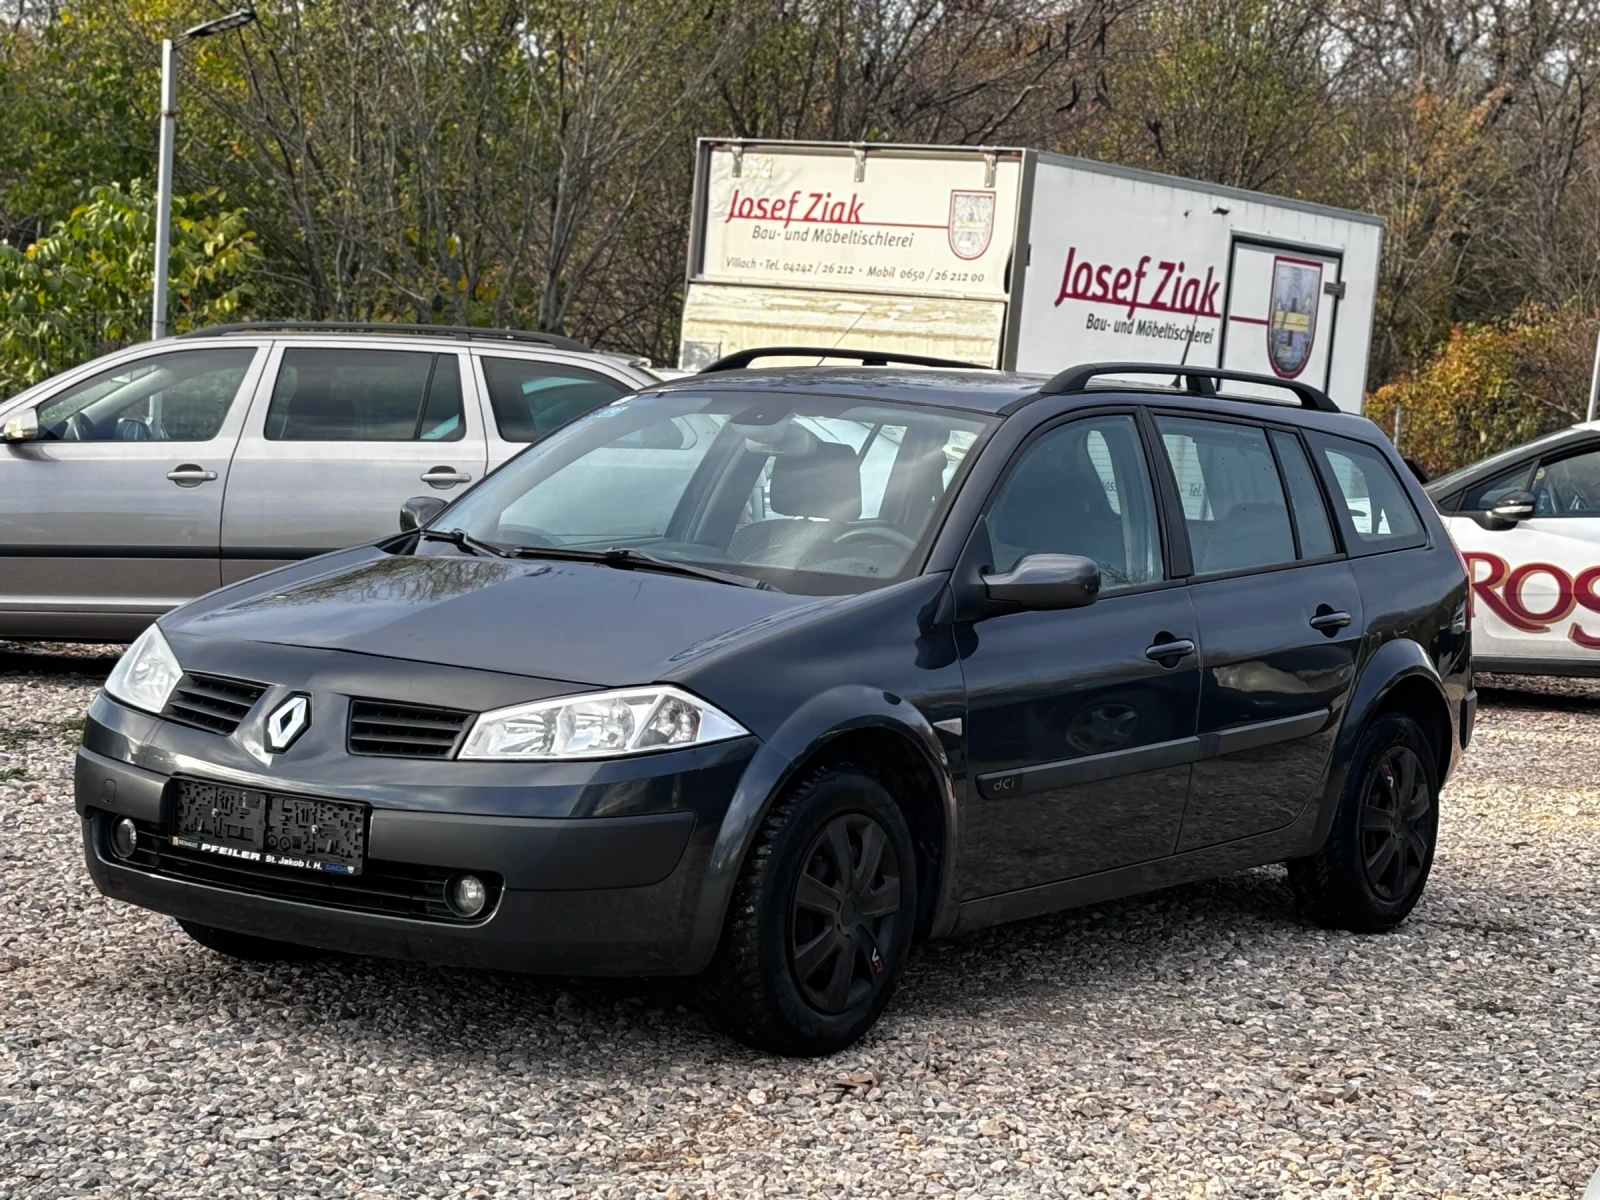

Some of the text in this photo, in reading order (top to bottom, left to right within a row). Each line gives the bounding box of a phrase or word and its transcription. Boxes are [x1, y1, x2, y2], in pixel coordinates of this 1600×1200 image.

[725, 189, 865, 229] Josef Ziak
[752, 225, 914, 248] Bau- und Möbeltischlerei
[726, 257, 757, 269] Villach
[765, 259, 780, 271] Tel.
[783, 262, 813, 274] 04242
[822, 263, 836, 274] 26
[836, 265, 854, 275] 212
[867, 265, 897, 278] Mobil
[899, 268, 925, 282] 0650
[934, 269, 948, 281] 26
[949, 273, 968, 282] 212
[970, 273, 985, 283] 00
[1054, 247, 1221, 319] Josef Ziak
[1086, 313, 1214, 344] Bau- und Möbeltischlerei
[1189, 484, 1202, 497] Tel.
[993, 778, 1015, 791] dCi
[201, 843, 261, 861] PFEILER
[265, 854, 277, 863] St.
[278, 857, 305, 868] Jakob
[313, 861, 323, 870] H.
